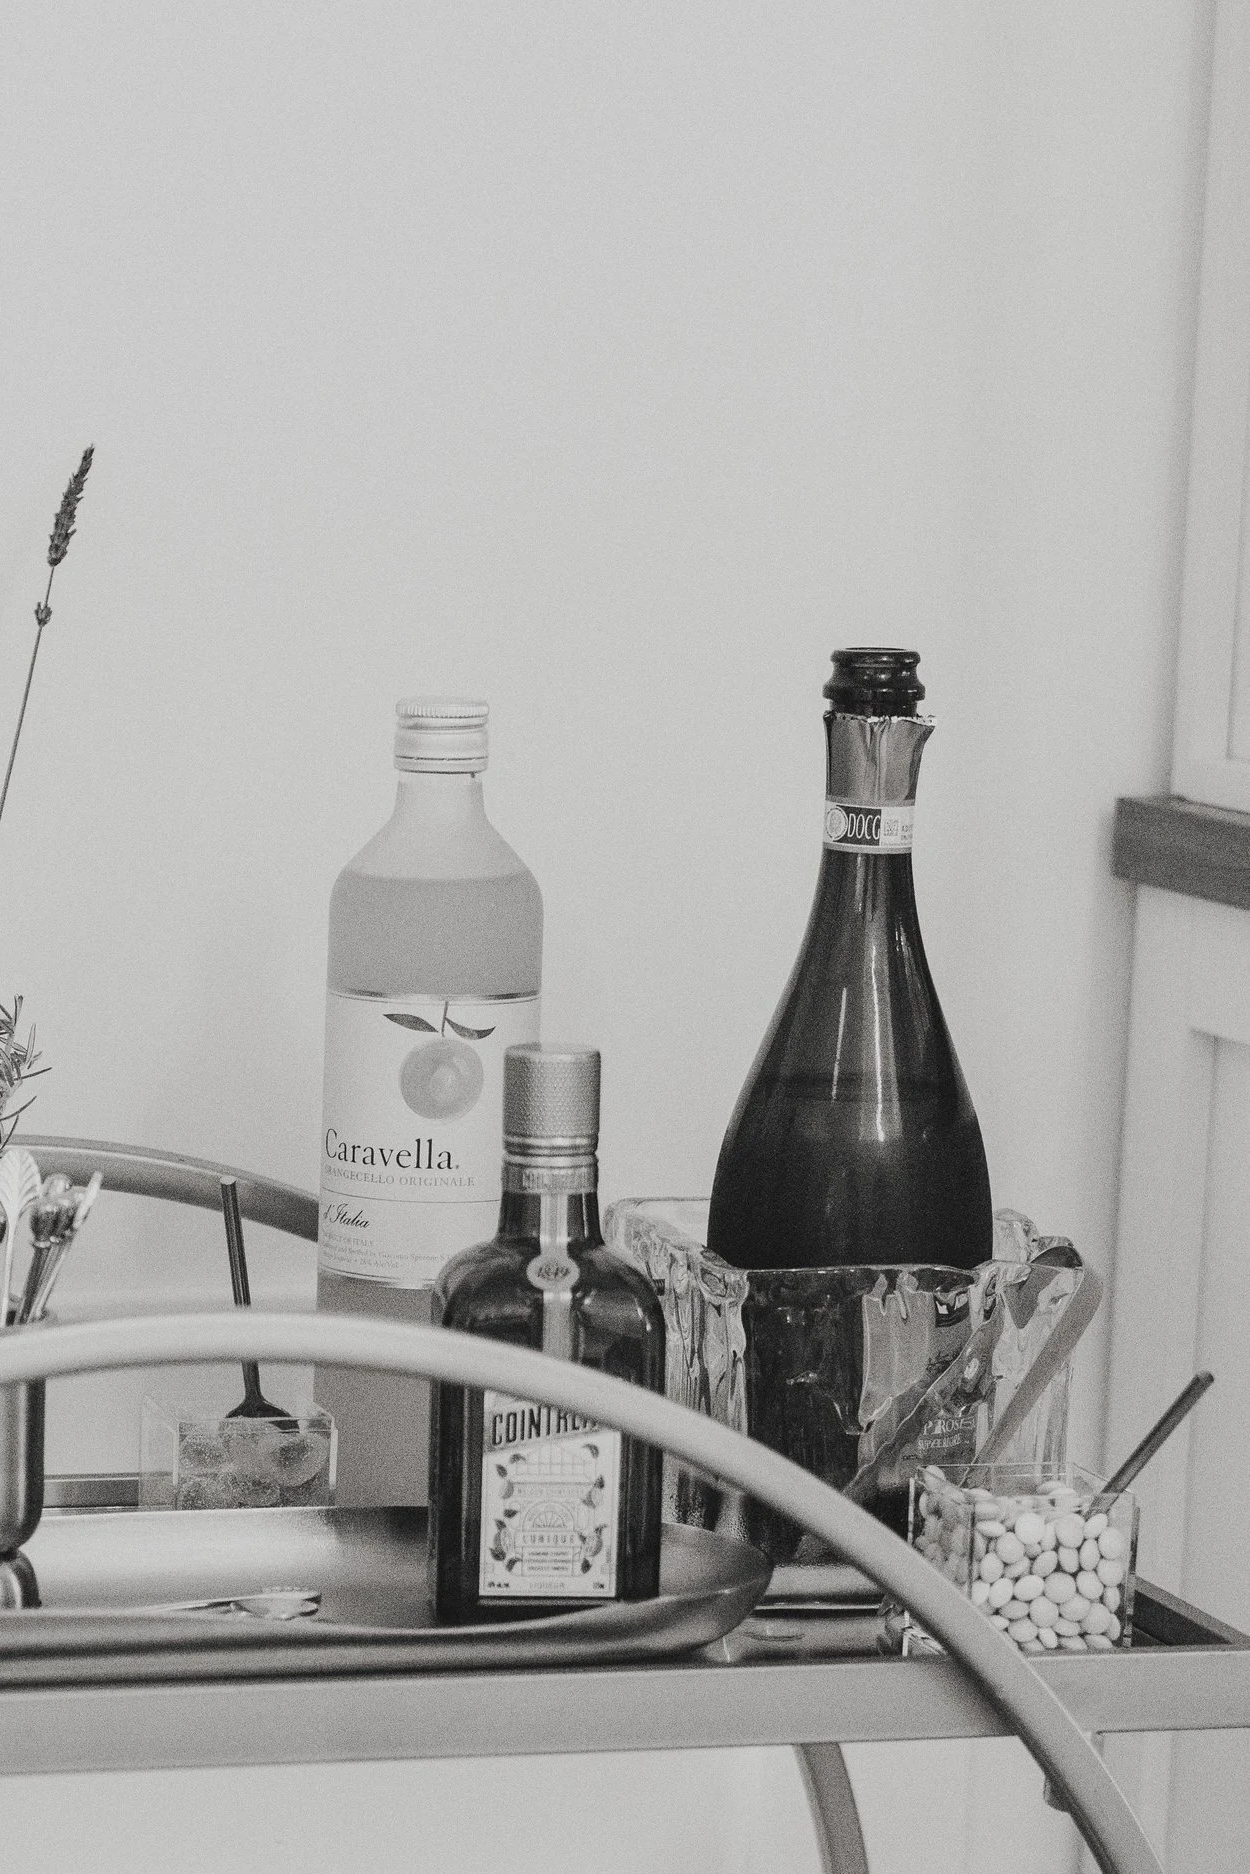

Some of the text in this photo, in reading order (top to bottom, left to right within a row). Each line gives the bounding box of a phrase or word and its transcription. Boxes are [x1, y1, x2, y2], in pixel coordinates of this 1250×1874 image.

[847, 813, 880, 840] DOCG
[399, 1176, 476, 1188] ORIGINALE
[492, 1405, 598, 1446] COINTRE
